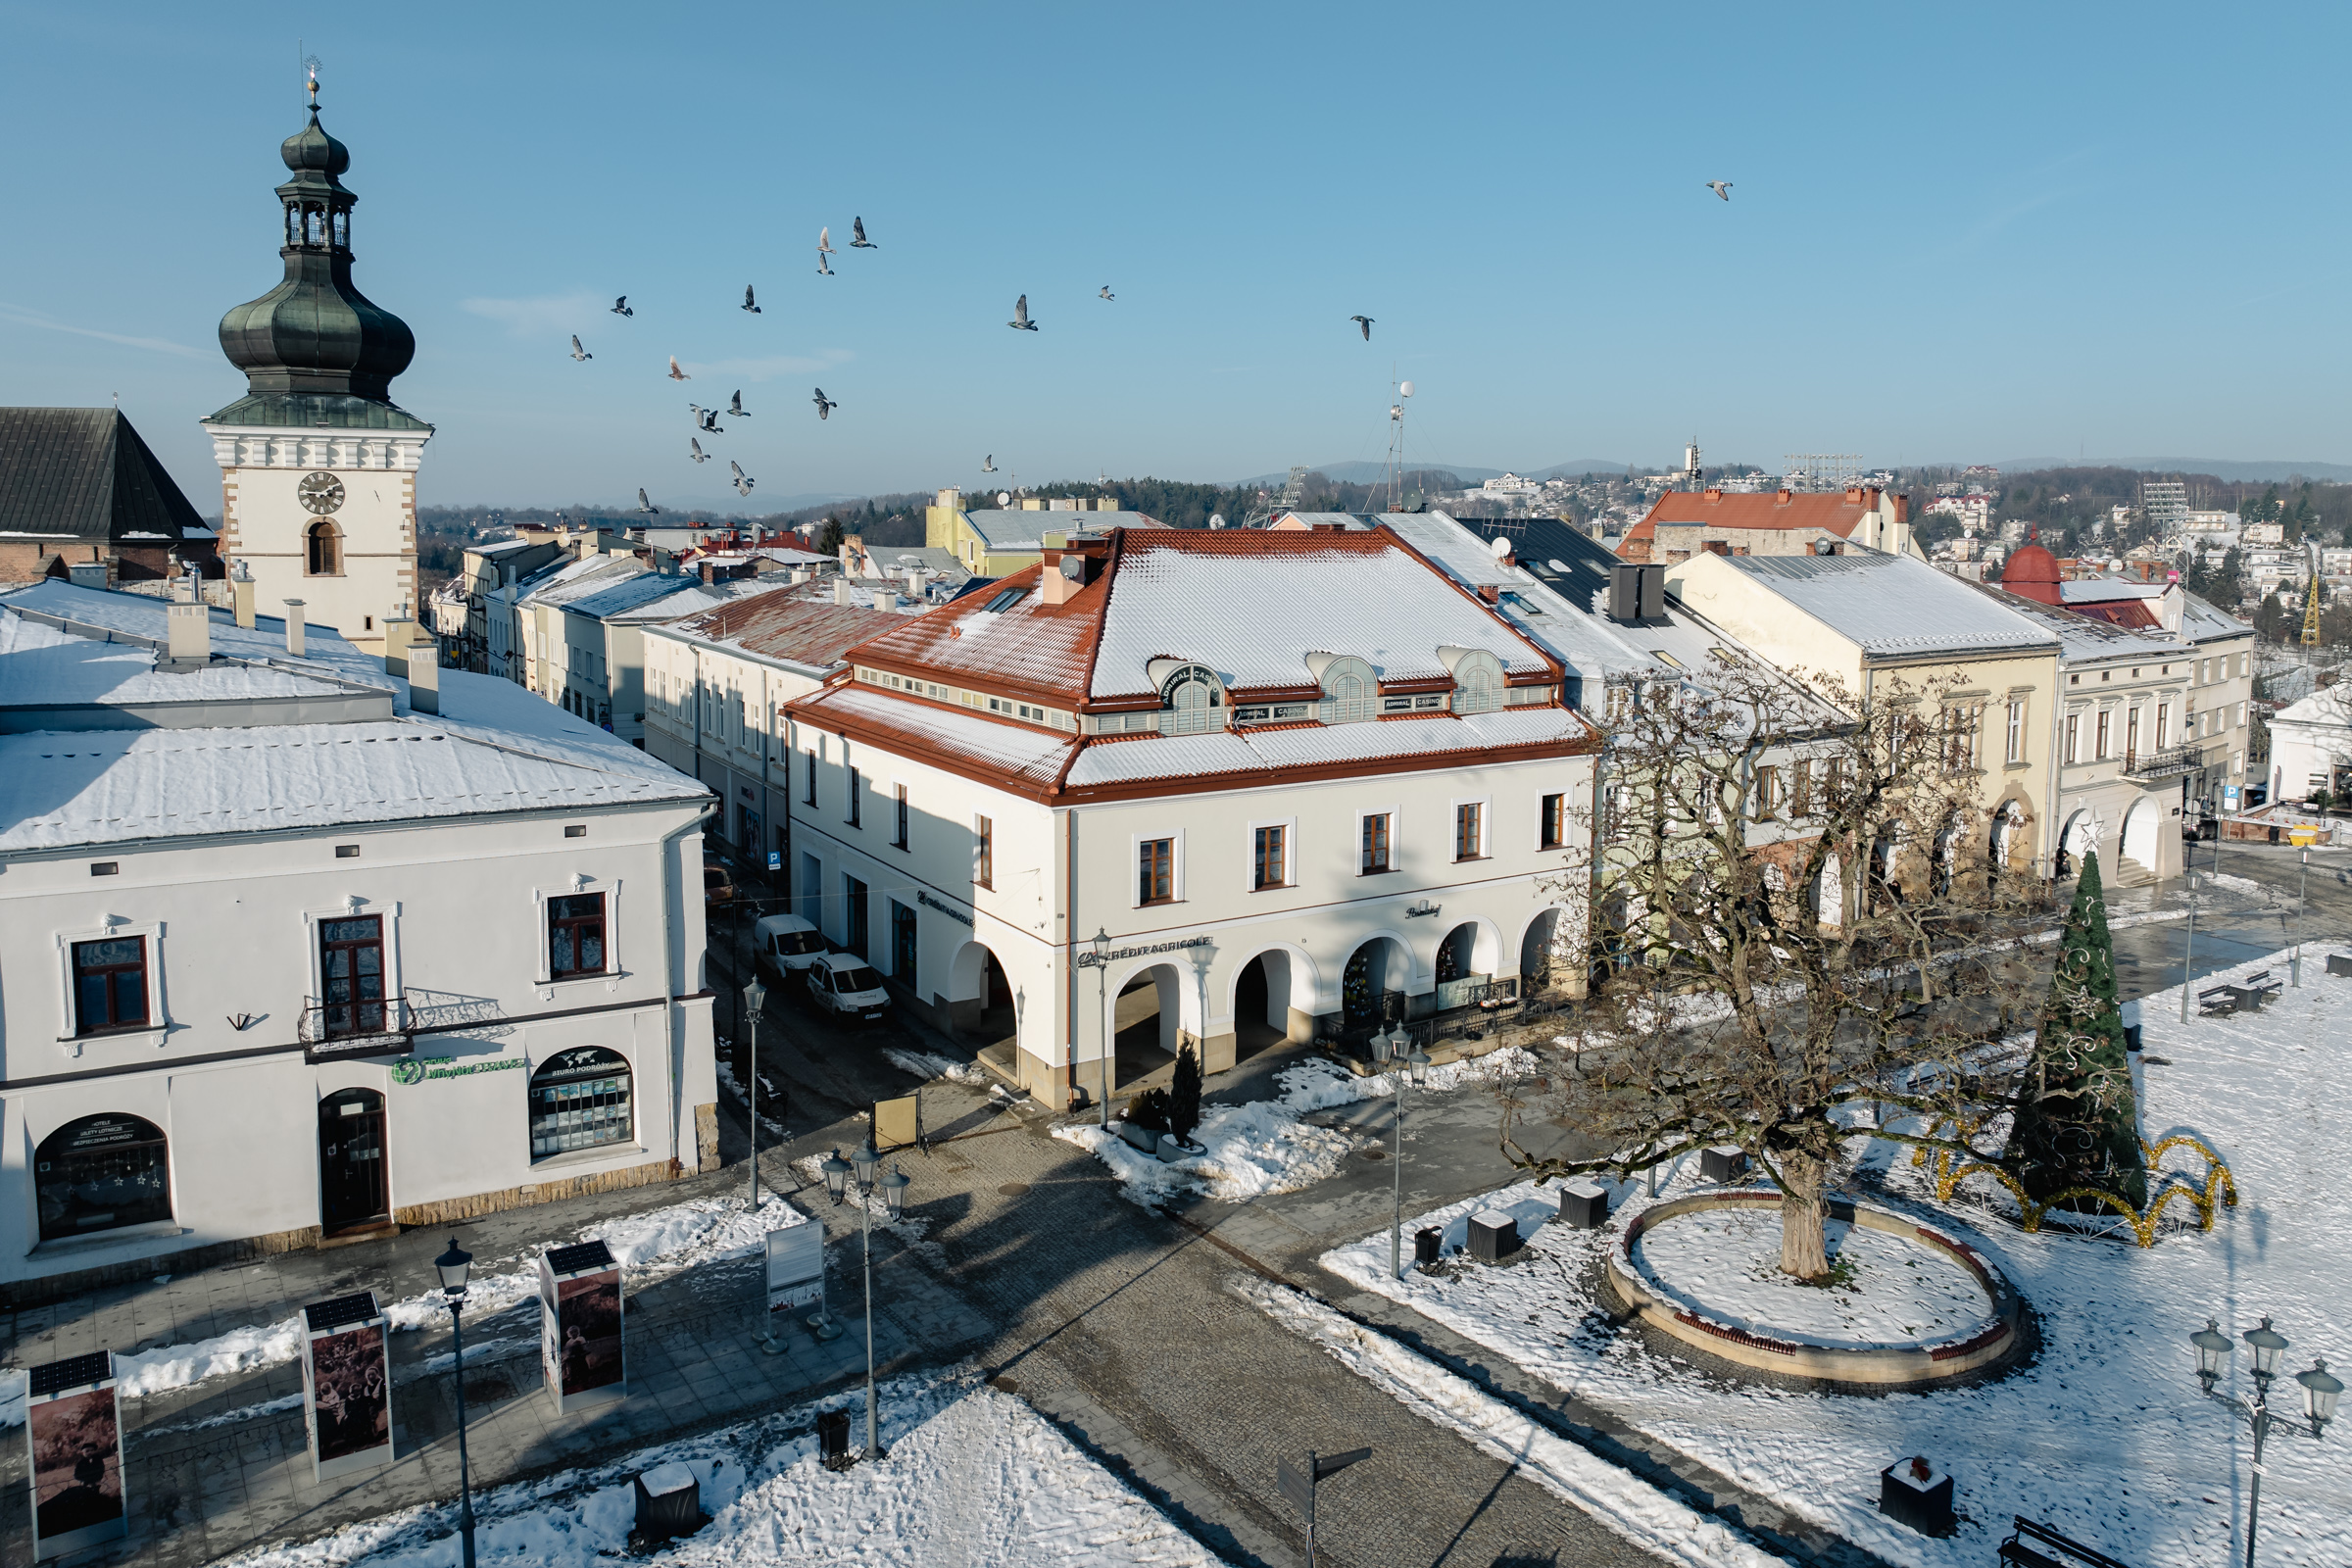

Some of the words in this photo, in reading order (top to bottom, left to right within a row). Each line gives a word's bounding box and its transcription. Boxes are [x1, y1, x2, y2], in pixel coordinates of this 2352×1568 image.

[1162, 670, 1190, 705] ADMIRAL
[2228, 787, 2236, 797] P
[770, 853, 778, 862] P
[1151, 936, 1210, 954] AGRICOLE
[552, 1067, 575, 1076] BIURO
